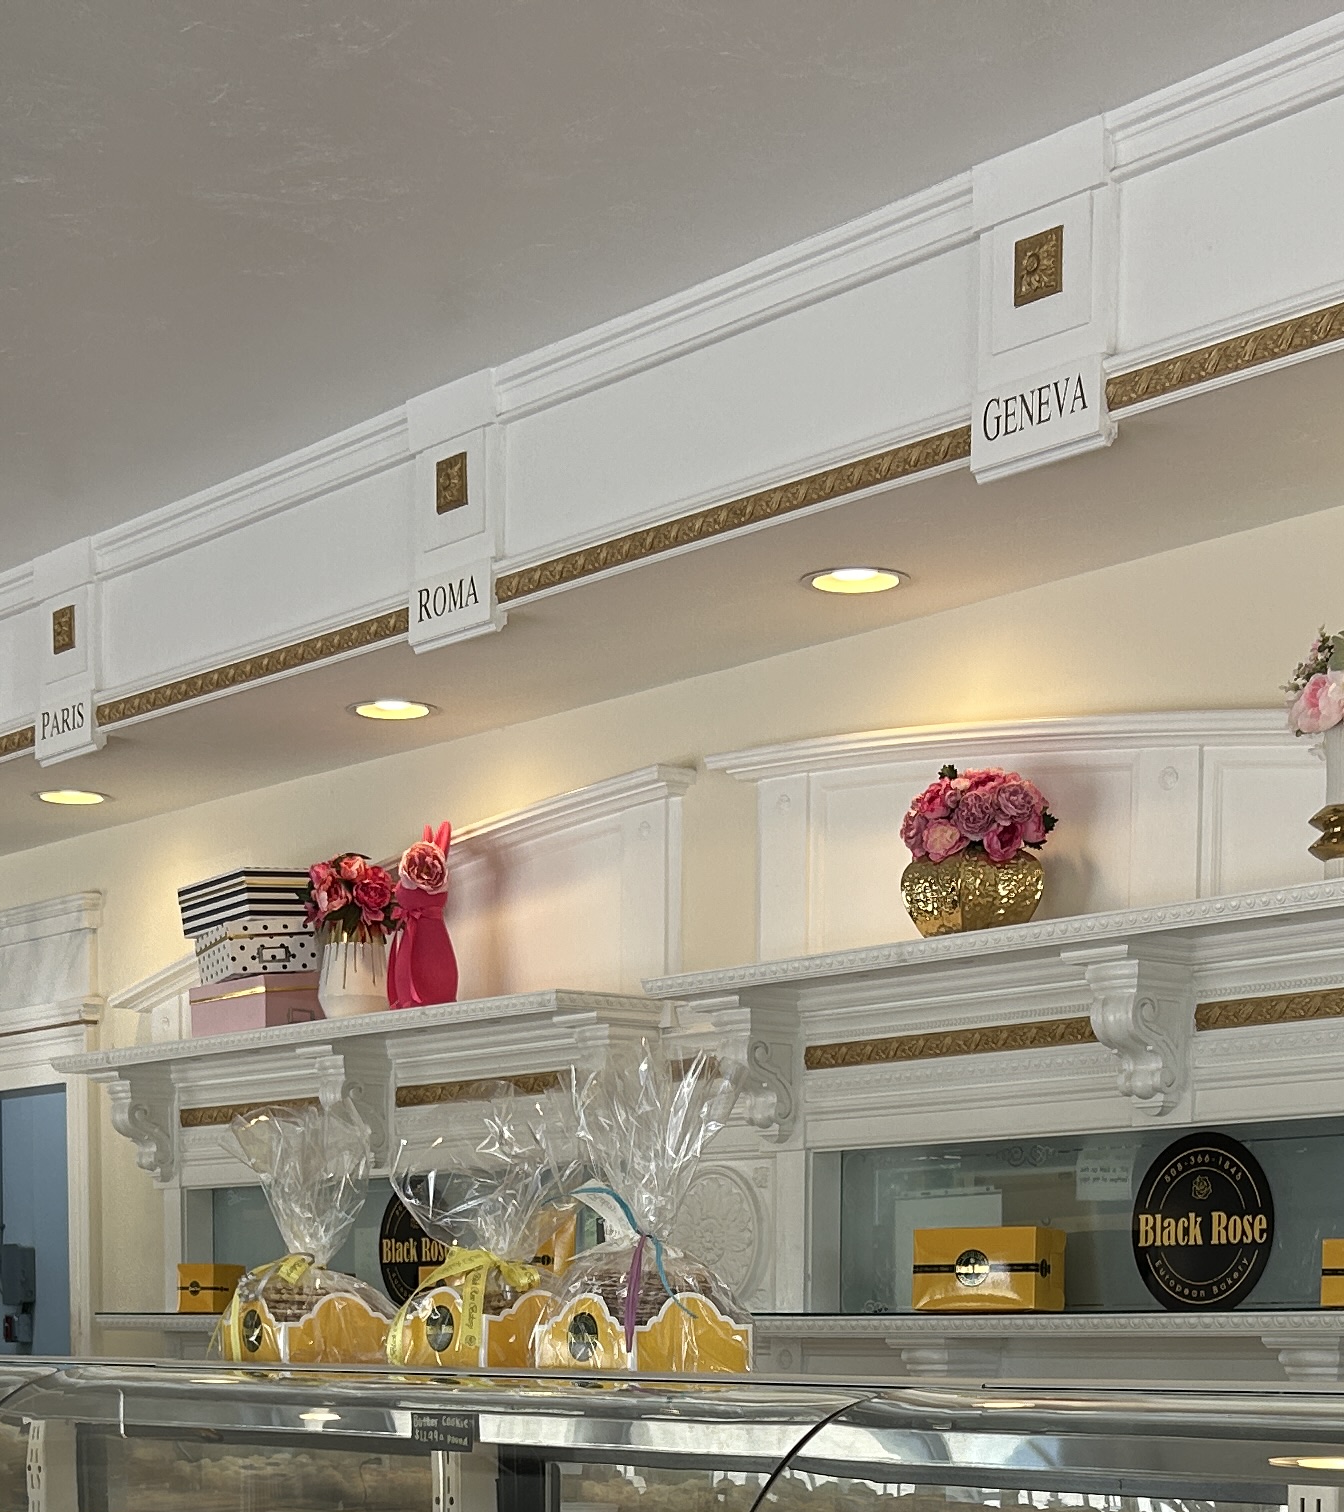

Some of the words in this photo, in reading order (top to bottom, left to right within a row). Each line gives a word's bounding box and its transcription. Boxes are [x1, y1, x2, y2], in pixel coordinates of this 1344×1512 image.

[981, 373, 1089, 443] GENEVA
[417, 574, 480, 624] ROMA
[40, 702, 85, 740] PARIS
[1138, 1212, 1203, 1247] Black
[1211, 1211, 1268, 1244] Rose
[382, 1238, 418, 1263] Black
[1155, 1259, 1206, 1298] European
[1212, 1257, 1249, 1296] Bakery
